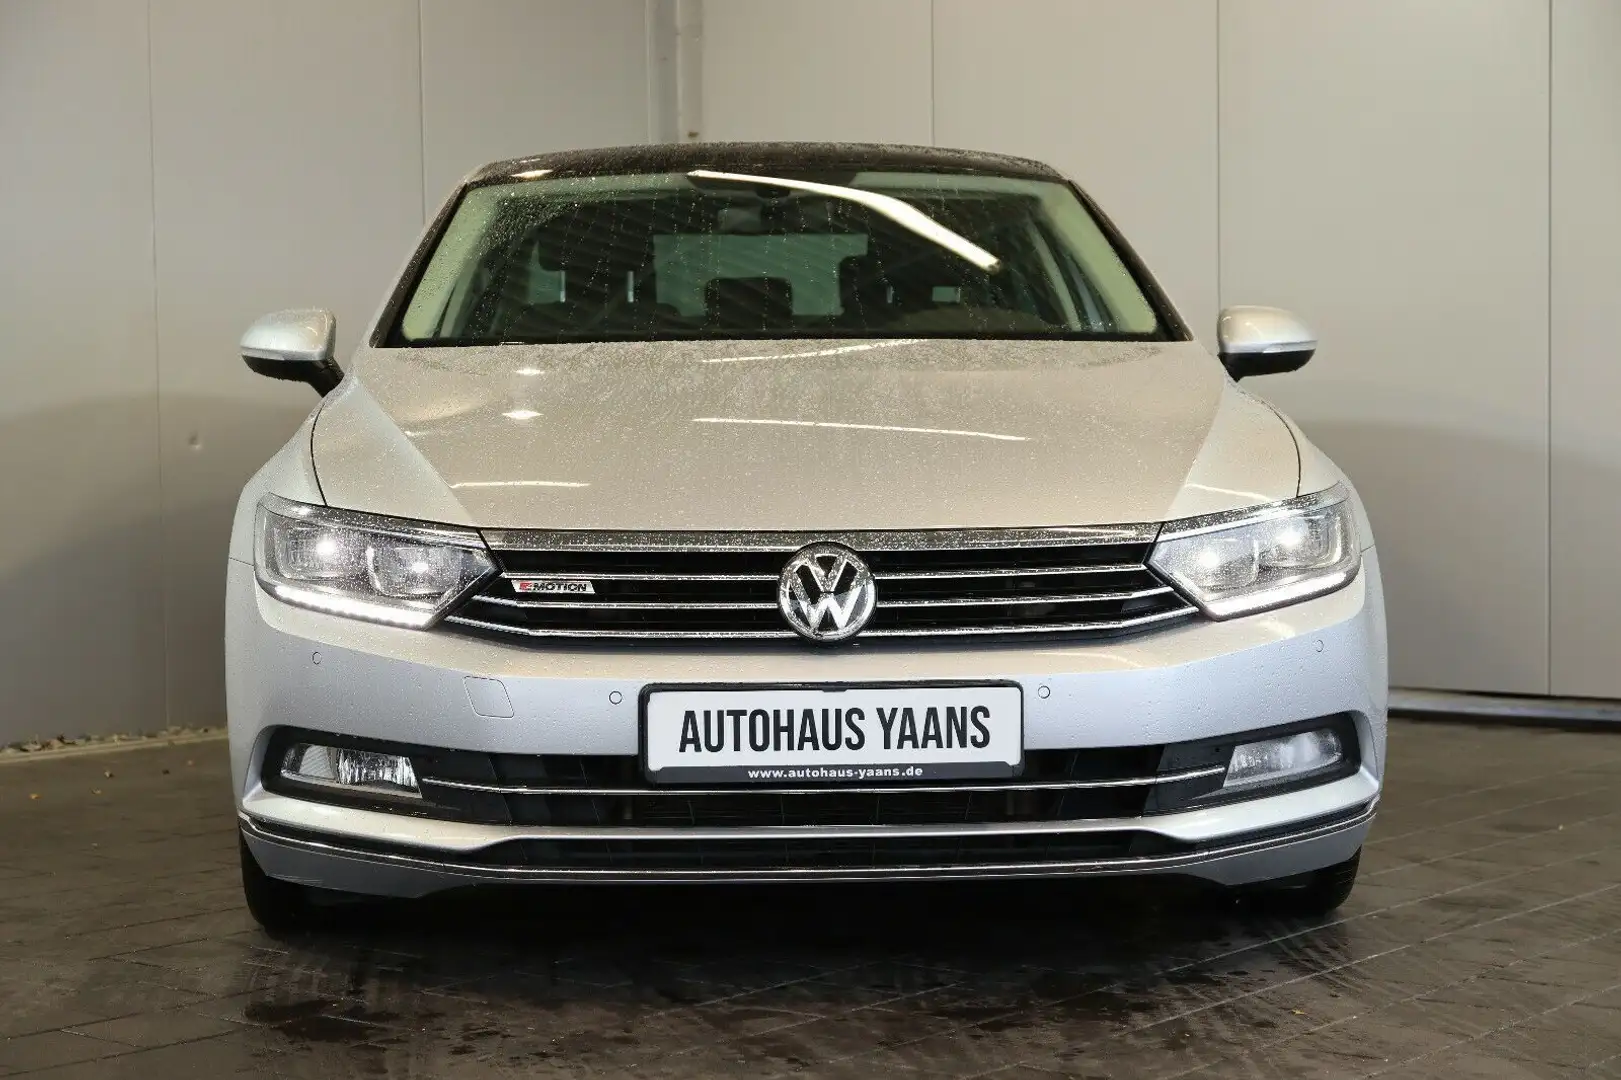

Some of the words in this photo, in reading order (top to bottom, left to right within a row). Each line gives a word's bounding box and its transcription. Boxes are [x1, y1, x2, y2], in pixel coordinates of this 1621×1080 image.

[785, 546, 874, 636] VW
[679, 707, 866, 753] AUTOHAUS
[876, 705, 991, 750] YAANS
[748, 766, 923, 779] www.autohaus-yaans.de
